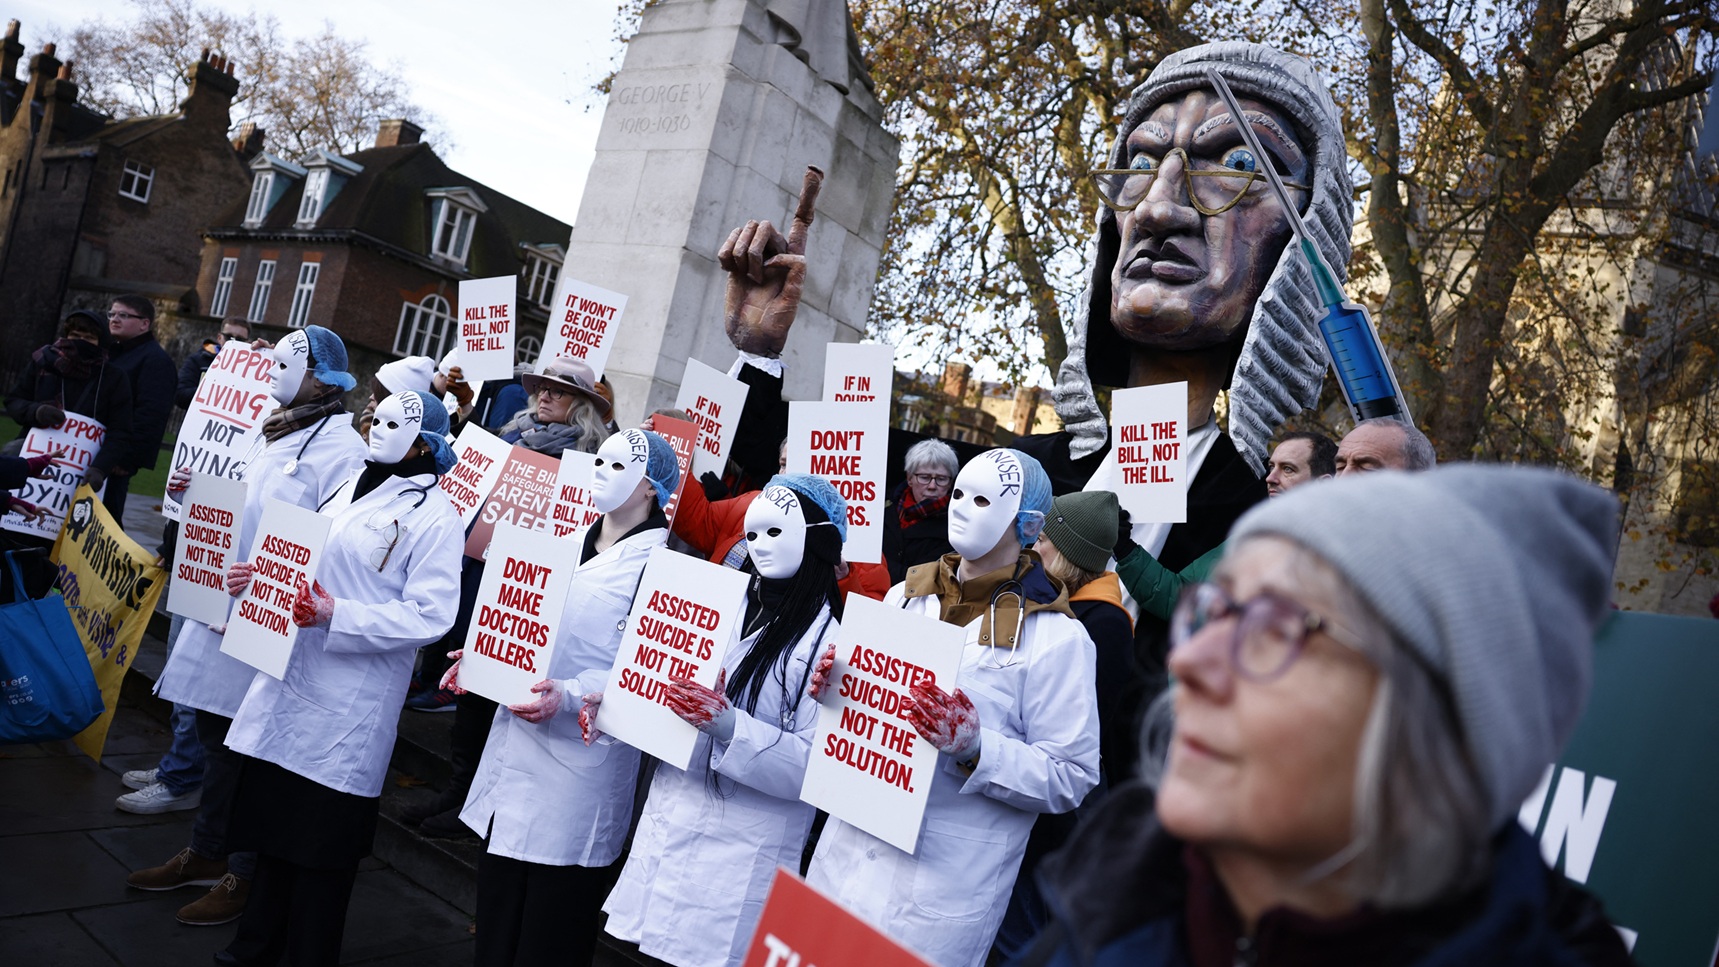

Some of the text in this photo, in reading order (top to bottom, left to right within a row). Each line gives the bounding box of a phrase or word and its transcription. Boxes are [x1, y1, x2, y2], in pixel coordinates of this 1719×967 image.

[618, 84, 691, 105] GEORGE
[465, 304, 508, 321] KILL THE
[565, 293, 617, 321] IT WON'T
[462, 320, 510, 338] BILL, NOT
[565, 309, 607, 334] BE OUR
[466, 337, 505, 352] THE ILL.
[560, 324, 603, 348] CHOICE
[564, 341, 588, 359] FOR
[844, 375, 870, 392] IF IN
[695, 395, 722, 419] IF IN
[200, 419, 245, 447] NOT
[810, 430, 864, 451] DON'T
[1120, 421, 1177, 443] KILL THE
[461, 446, 494, 472] DON'T
[702, 436, 721, 457] NO.
[1118, 442, 1180, 465] BILL, NOT
[452, 462, 483, 488] MAKE
[508, 459, 557, 487] THE BIL
[810, 455, 861, 476] MAKE
[1122, 465, 1174, 485] THE ILL.
[560, 484, 583, 505] KILL
[830, 480, 876, 502] TORS
[188, 503, 233, 528] ASSISTED
[552, 503, 601, 527] BILL, NO
[184, 523, 232, 549] SUICIDE IS
[185, 544, 225, 570] NOT THE
[261, 534, 311, 566] ASSISTED
[178, 563, 225, 592] SOLUTION.
[253, 555, 295, 587] SUICIDE
[502, 556, 552, 590] DON'T
[250, 579, 295, 612] NOT THE
[497, 582, 544, 617] MAKE
[239, 599, 290, 637] SOLUTION.
[646, 589, 720, 632] ASSISTED
[478, 604, 550, 648] DOCTORS
[636, 615, 714, 661] SUICIDE IS
[115, 644, 127, 667] &
[473, 631, 537, 674] KILLERS.
[634, 643, 699, 680] NOT THE
[848, 644, 936, 689] ASSISTED
[839, 673, 911, 721] SUICIDE
[839, 706, 917, 758] NOT THE
[824, 733, 915, 793] SOLUTION.
